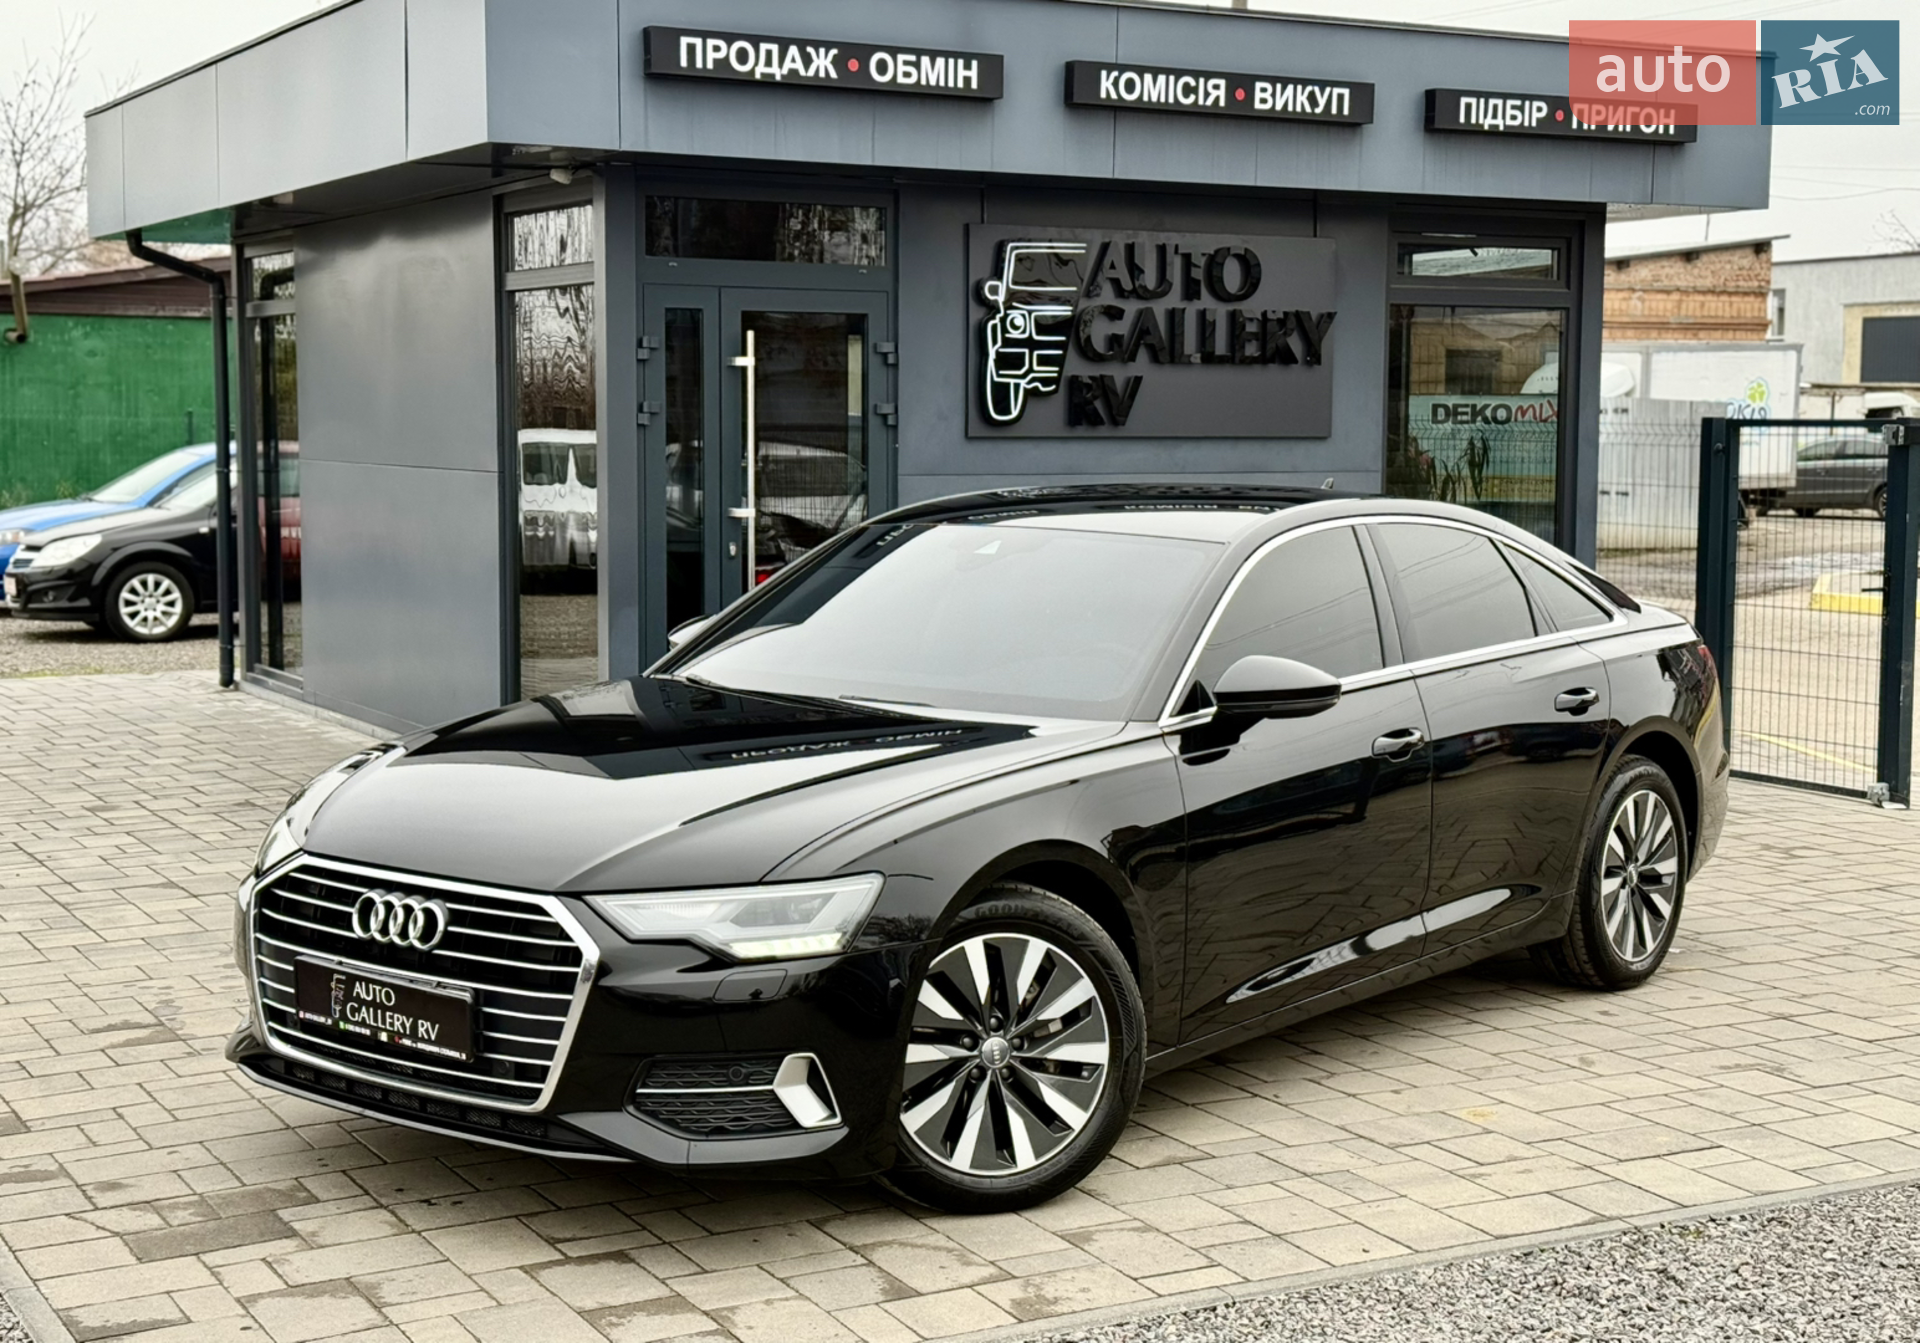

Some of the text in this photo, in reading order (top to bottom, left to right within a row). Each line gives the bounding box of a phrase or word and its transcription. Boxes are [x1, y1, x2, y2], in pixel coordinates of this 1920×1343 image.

[678, 35, 979, 91] ПРОДАЖ ОБМІН
[1100, 69, 1350, 116] КОМІСІЯ ВИКУП
[1458, 96, 1676, 136] ПІДБІР ПРИГОН
[1085, 240, 1262, 302] AUTO
[1075, 304, 1337, 365] GALLERY
[1068, 374, 1143, 427] RV
[352, 980, 396, 1007] AUTO
[346, 1002, 414, 1036] GALLERY
[417, 1019, 440, 1041] RV
